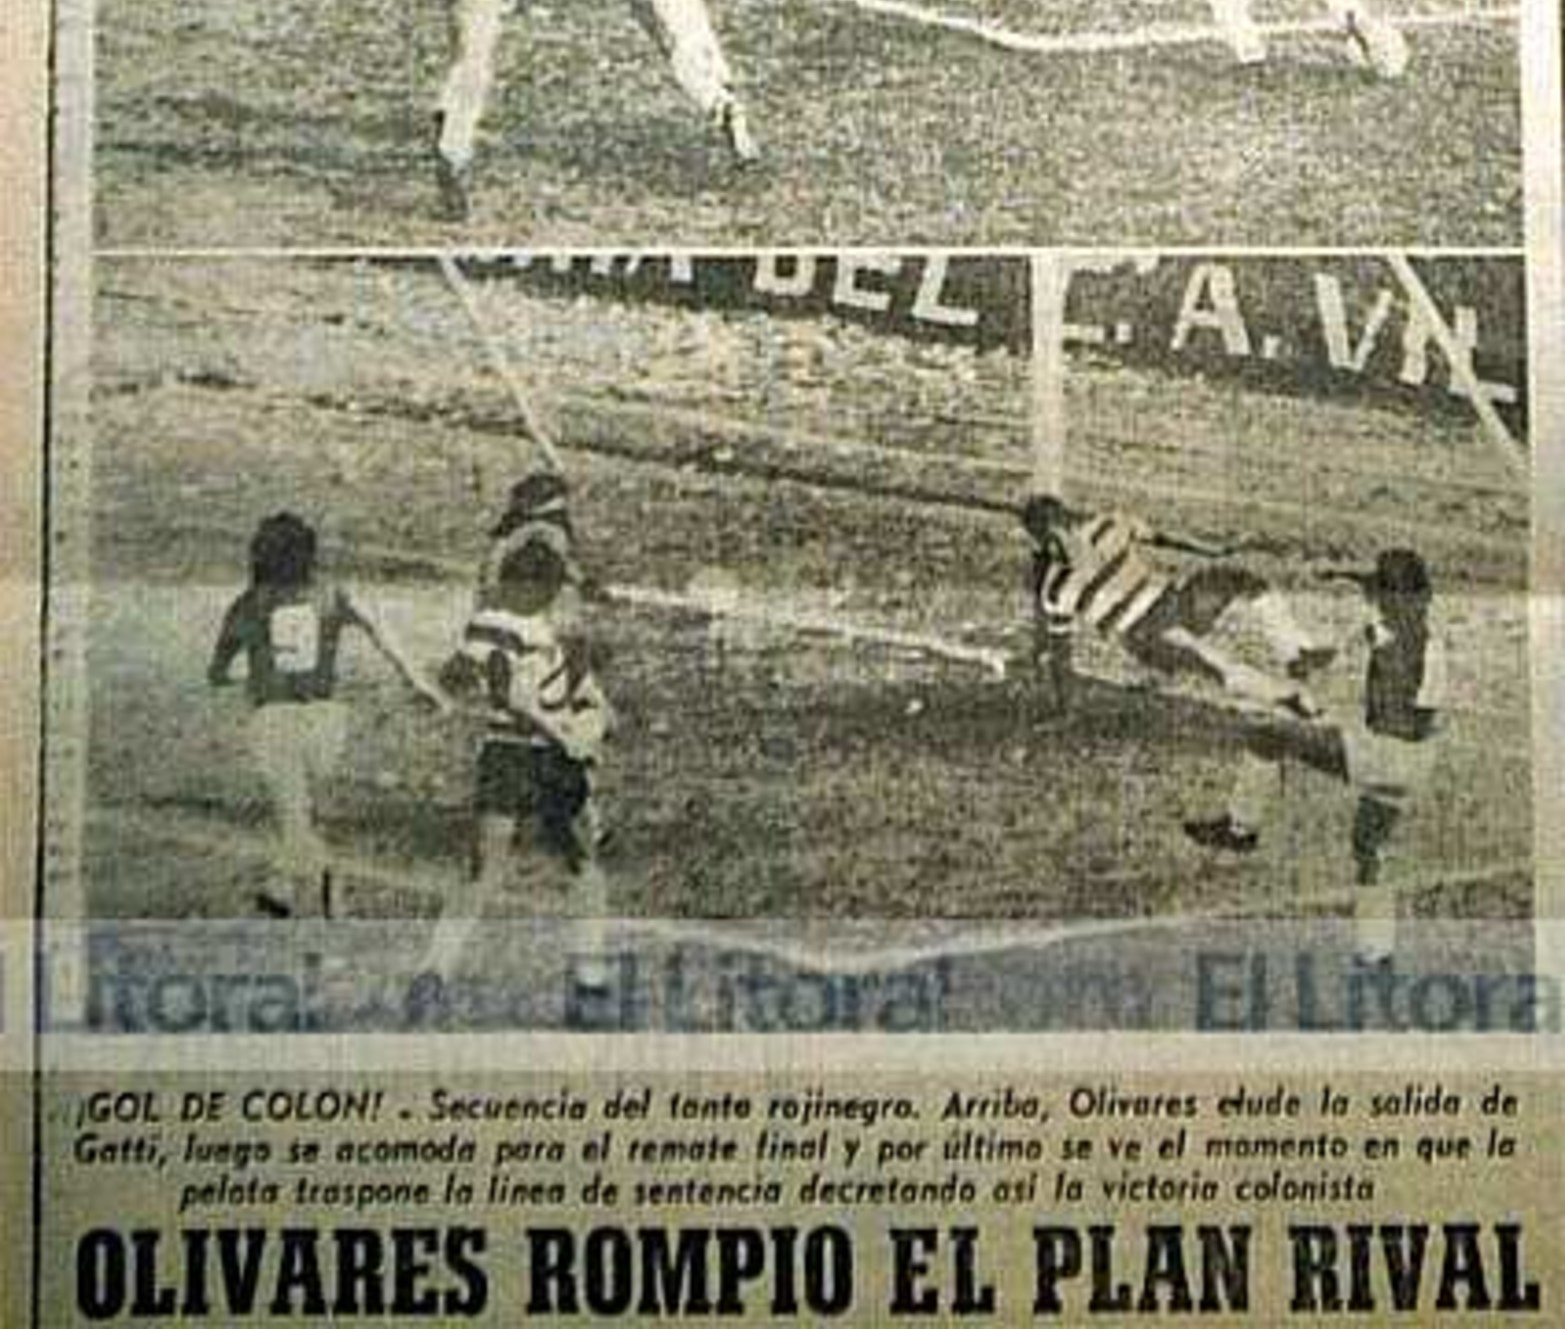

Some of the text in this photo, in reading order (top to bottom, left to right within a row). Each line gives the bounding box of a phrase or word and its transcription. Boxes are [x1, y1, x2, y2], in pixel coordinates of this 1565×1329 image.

[179, 1090, 225, 1123] DE
[241, 1088, 383, 1122] COLON!
[428, 1086, 588, 1121] Secuencia
[602, 1087, 651, 1120] del
[670, 1090, 751, 1120] tanto
[766, 1086, 921, 1126] rojinegro.
[938, 1086, 1050, 1123] Arriba,
[1069, 1086, 1199, 1120] Olivares
[1320, 1085, 1349, 1117] la
[1370, 1084, 1461, 1118] salida
[1480, 1084, 1519, 1117] de
[73, 1131, 168, 1169] Gatti,
[184, 1132, 272, 1169] luego
[288, 1140, 321, 1164] se
[335, 1132, 477, 1164] acomoda
[494, 1139, 566, 1167] para
[581, 1130, 611, 1162] el
[627, 1135, 738, 1163] remate
[756, 1129, 830, 1162] final
[843, 1137, 862, 1167] y
[877, 1137, 929, 1165] por
[1061, 1136, 1094, 1162] se
[1109, 1136, 1143, 1161] ve
[1157, 1127, 1187, 1160] el
[1205, 1132, 1350, 1159] momento
[1364, 1135, 1401, 1160] en
[1416, 1136, 1473, 1164] que
[1487, 1127, 1518, 1159] la
[178, 1173, 280, 1213] pelota
[295, 1177, 430, 1209] traspone
[444, 1173, 475, 1206] la
[580, 1172, 620, 1206] de
[633, 1176, 782, 1205] sentencia
[799, 1172, 977, 1204] decretando
[1054, 1172, 1085, 1203] la
[1101, 1170, 1220, 1202] victoria
[1234, 1169, 1376, 1202] colonista
[76, 1224, 1543, 1319] OLIVARES ROMPIO EL PLAN RIVAL
